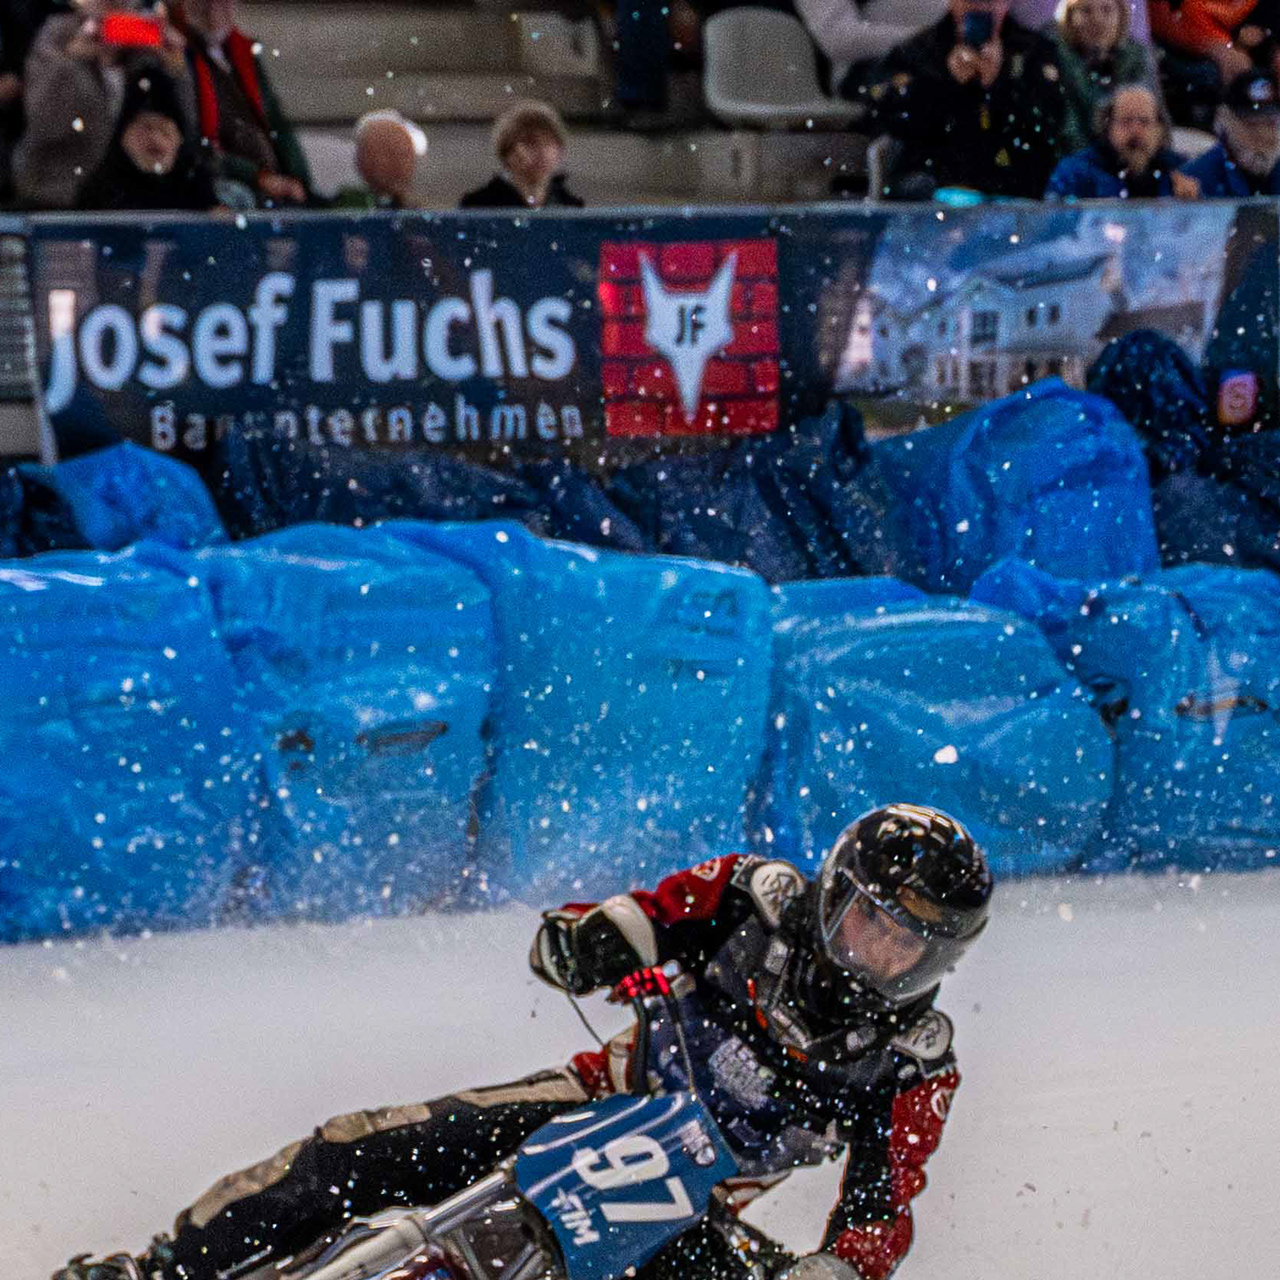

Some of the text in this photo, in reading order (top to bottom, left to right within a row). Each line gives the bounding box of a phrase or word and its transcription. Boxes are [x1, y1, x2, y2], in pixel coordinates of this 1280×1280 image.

[45, 268, 577, 413] Josef Fuchs
[675, 304, 708, 347] JF
[572, 1134, 694, 1223] 97
[551, 1187, 601, 1246] FIM
